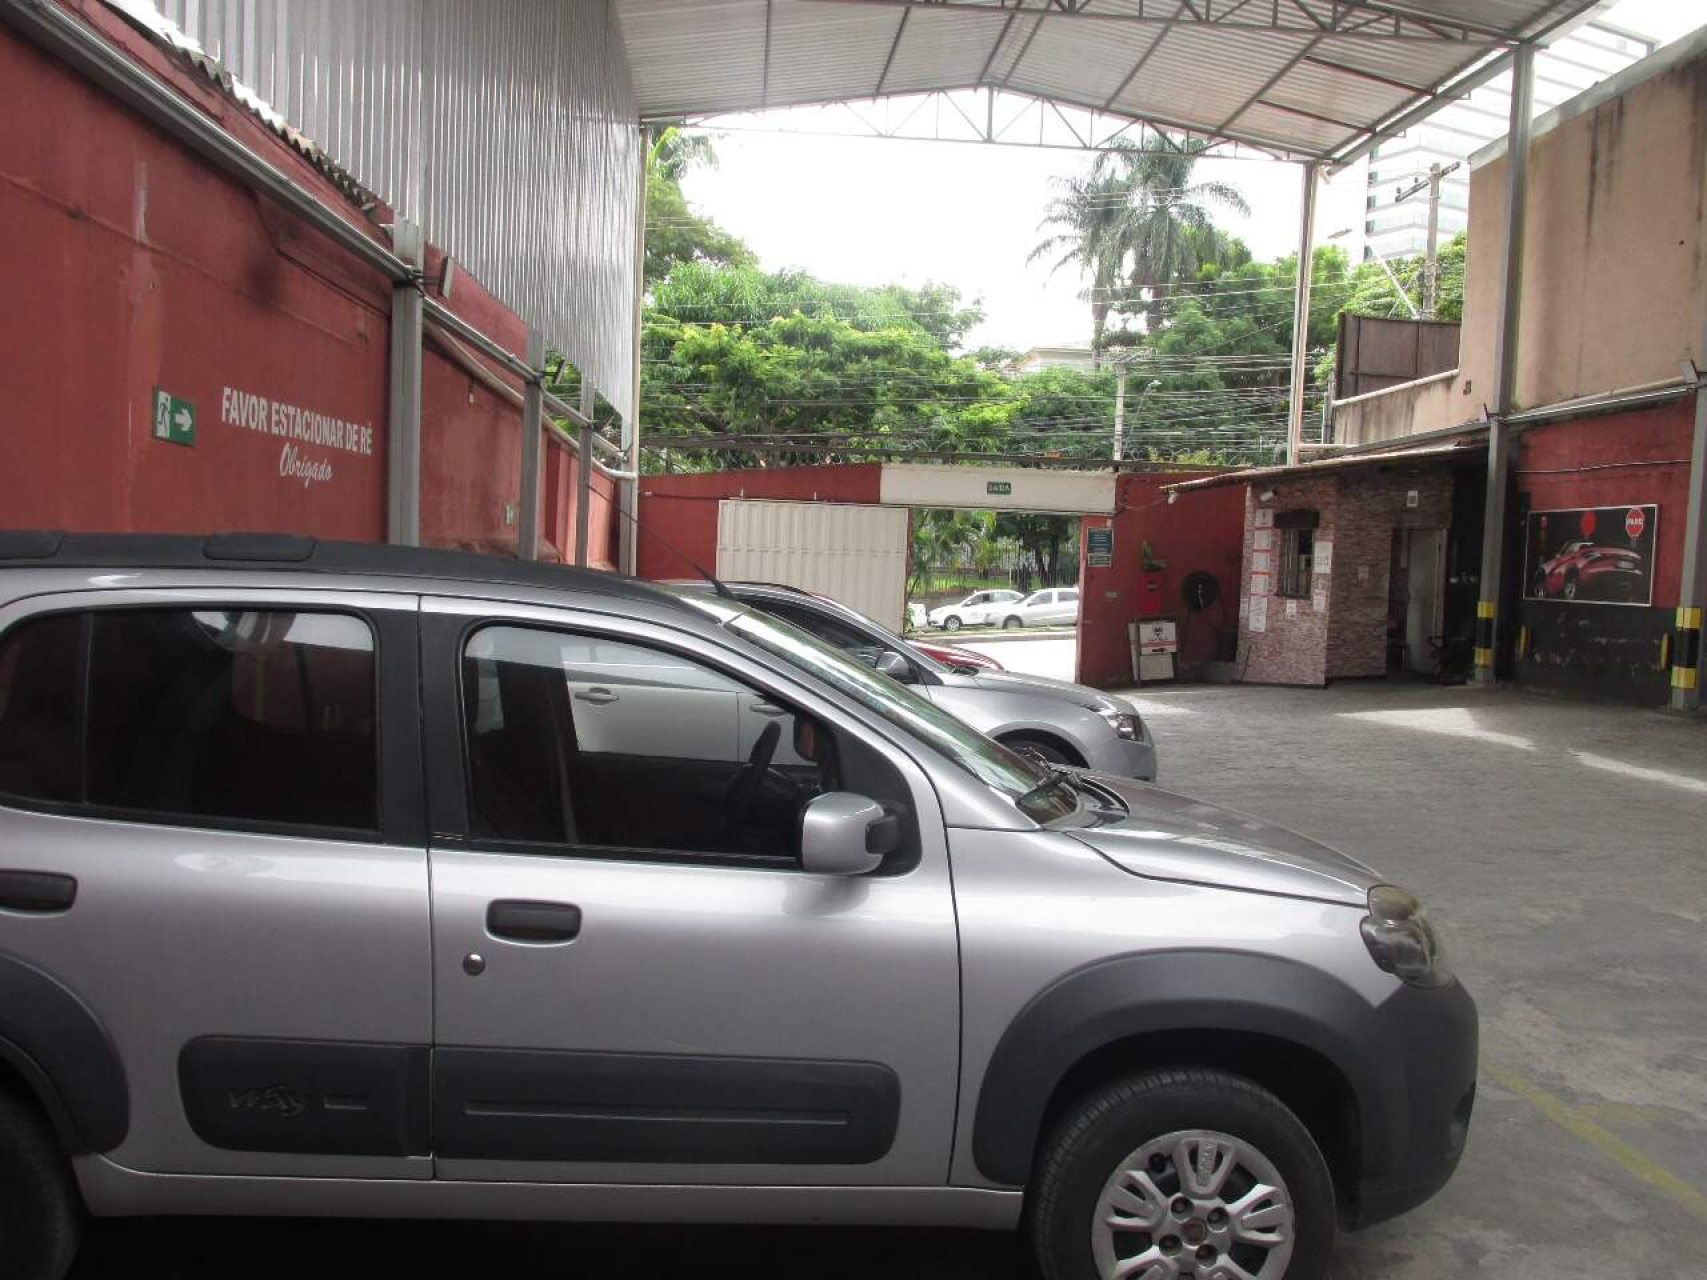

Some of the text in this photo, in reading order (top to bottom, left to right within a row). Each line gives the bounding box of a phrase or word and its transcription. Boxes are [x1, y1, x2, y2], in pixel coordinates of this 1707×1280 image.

[222, 386, 373, 455] FAVOR ESTACIONAR DE RÉ
[279, 442, 332, 487] Obrigado
